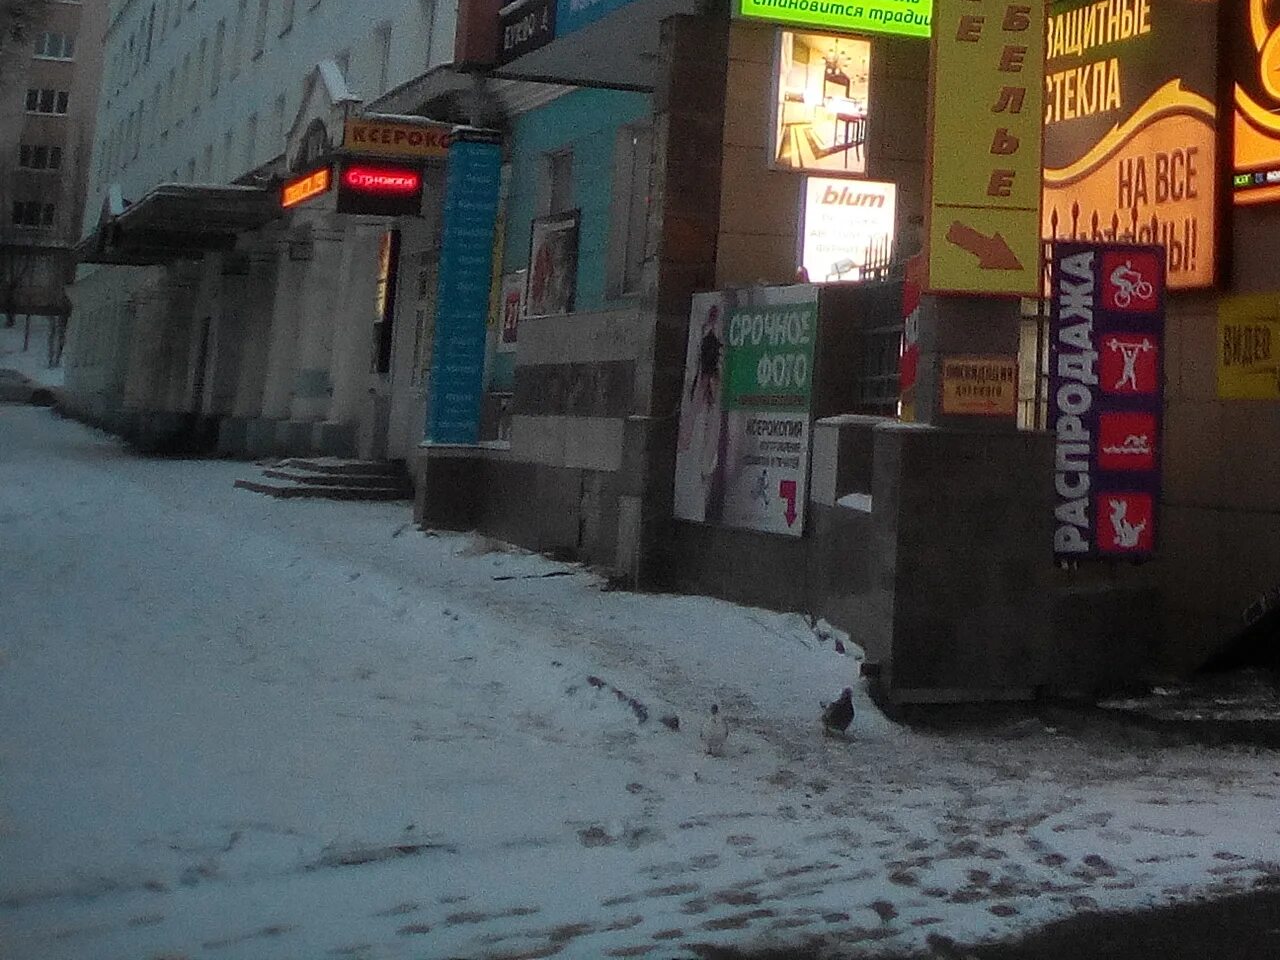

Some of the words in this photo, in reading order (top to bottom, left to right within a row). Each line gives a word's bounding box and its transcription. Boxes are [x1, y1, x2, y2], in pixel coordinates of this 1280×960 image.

[986, 4, 1031, 198] БЕЛЬЕ
[821, 184, 885, 208] blum
[1118, 158, 1147, 211] НА
[1155, 147, 1198, 202] ВСЕ
[729, 311, 811, 347] СРОЧНОЕ
[757, 353, 808, 388] ФОТО
[1054, 250, 1098, 554] РАСПРОДАЖА
